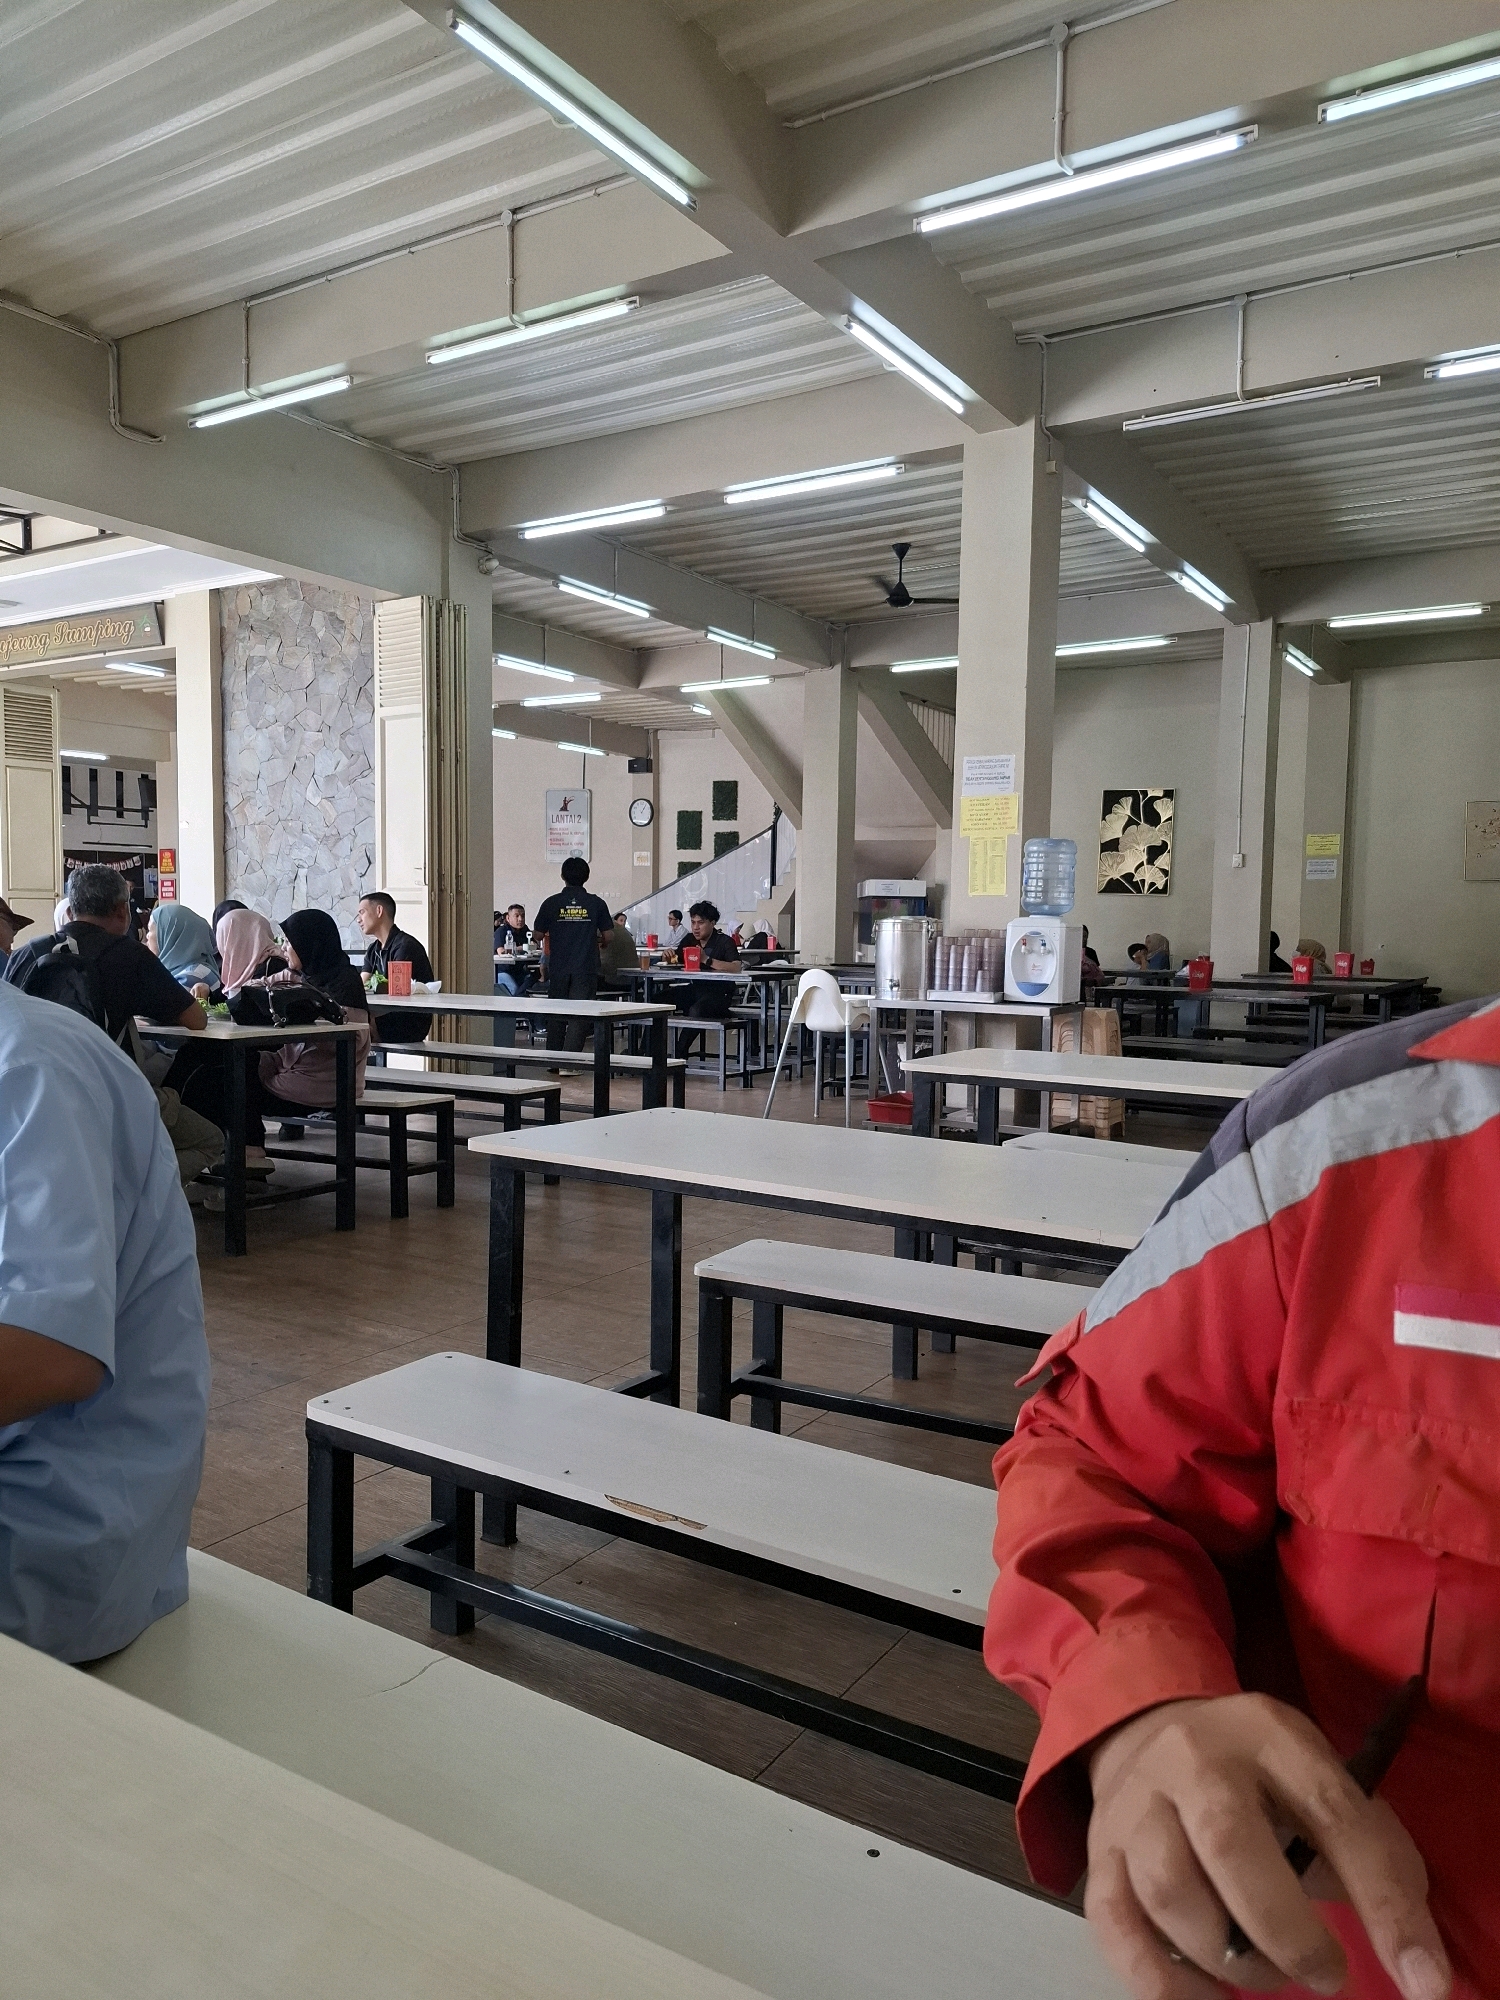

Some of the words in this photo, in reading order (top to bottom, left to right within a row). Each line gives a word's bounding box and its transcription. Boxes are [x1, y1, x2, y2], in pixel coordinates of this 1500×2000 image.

[54, 618, 134, 646] Sumping
[551, 814, 576, 824] LANTAI
[577, 814, 582, 824] 2
